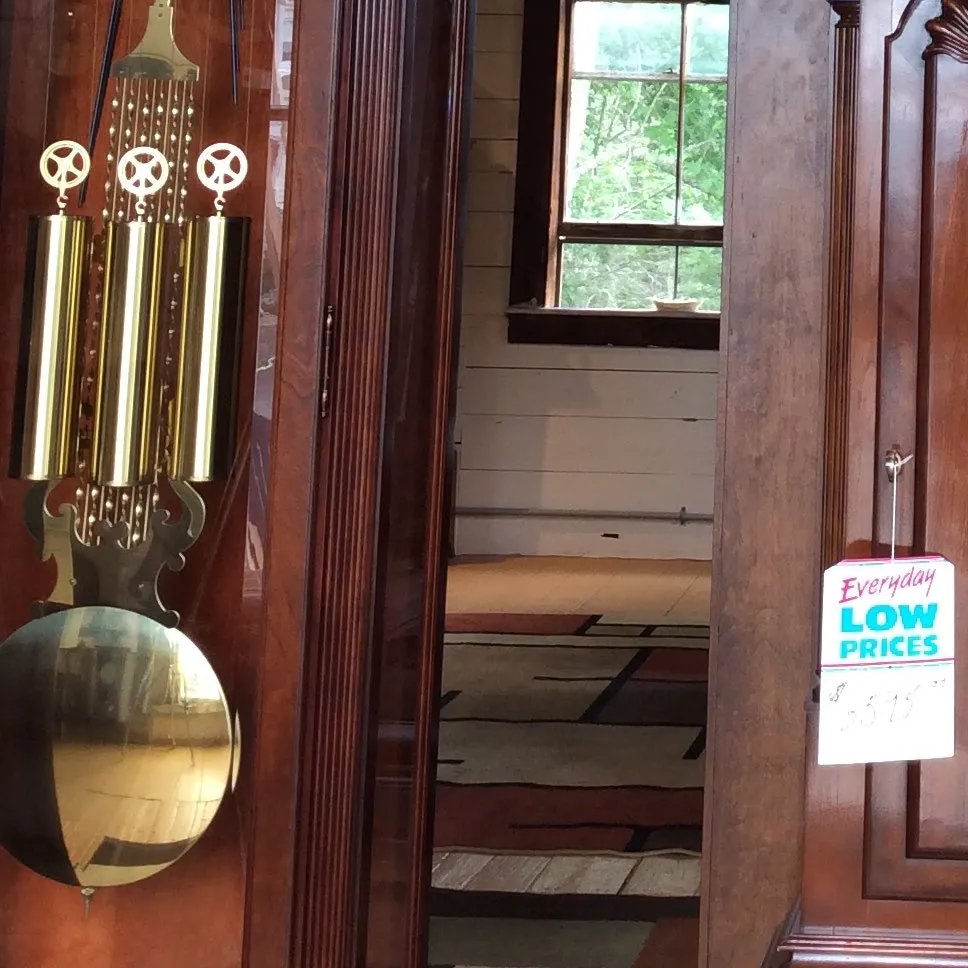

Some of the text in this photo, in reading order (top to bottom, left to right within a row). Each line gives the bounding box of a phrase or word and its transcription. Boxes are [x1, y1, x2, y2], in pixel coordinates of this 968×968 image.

[838, 566, 937, 604] Everyday
[840, 603, 939, 633] LOW
[839, 634, 939, 659] PRICES
